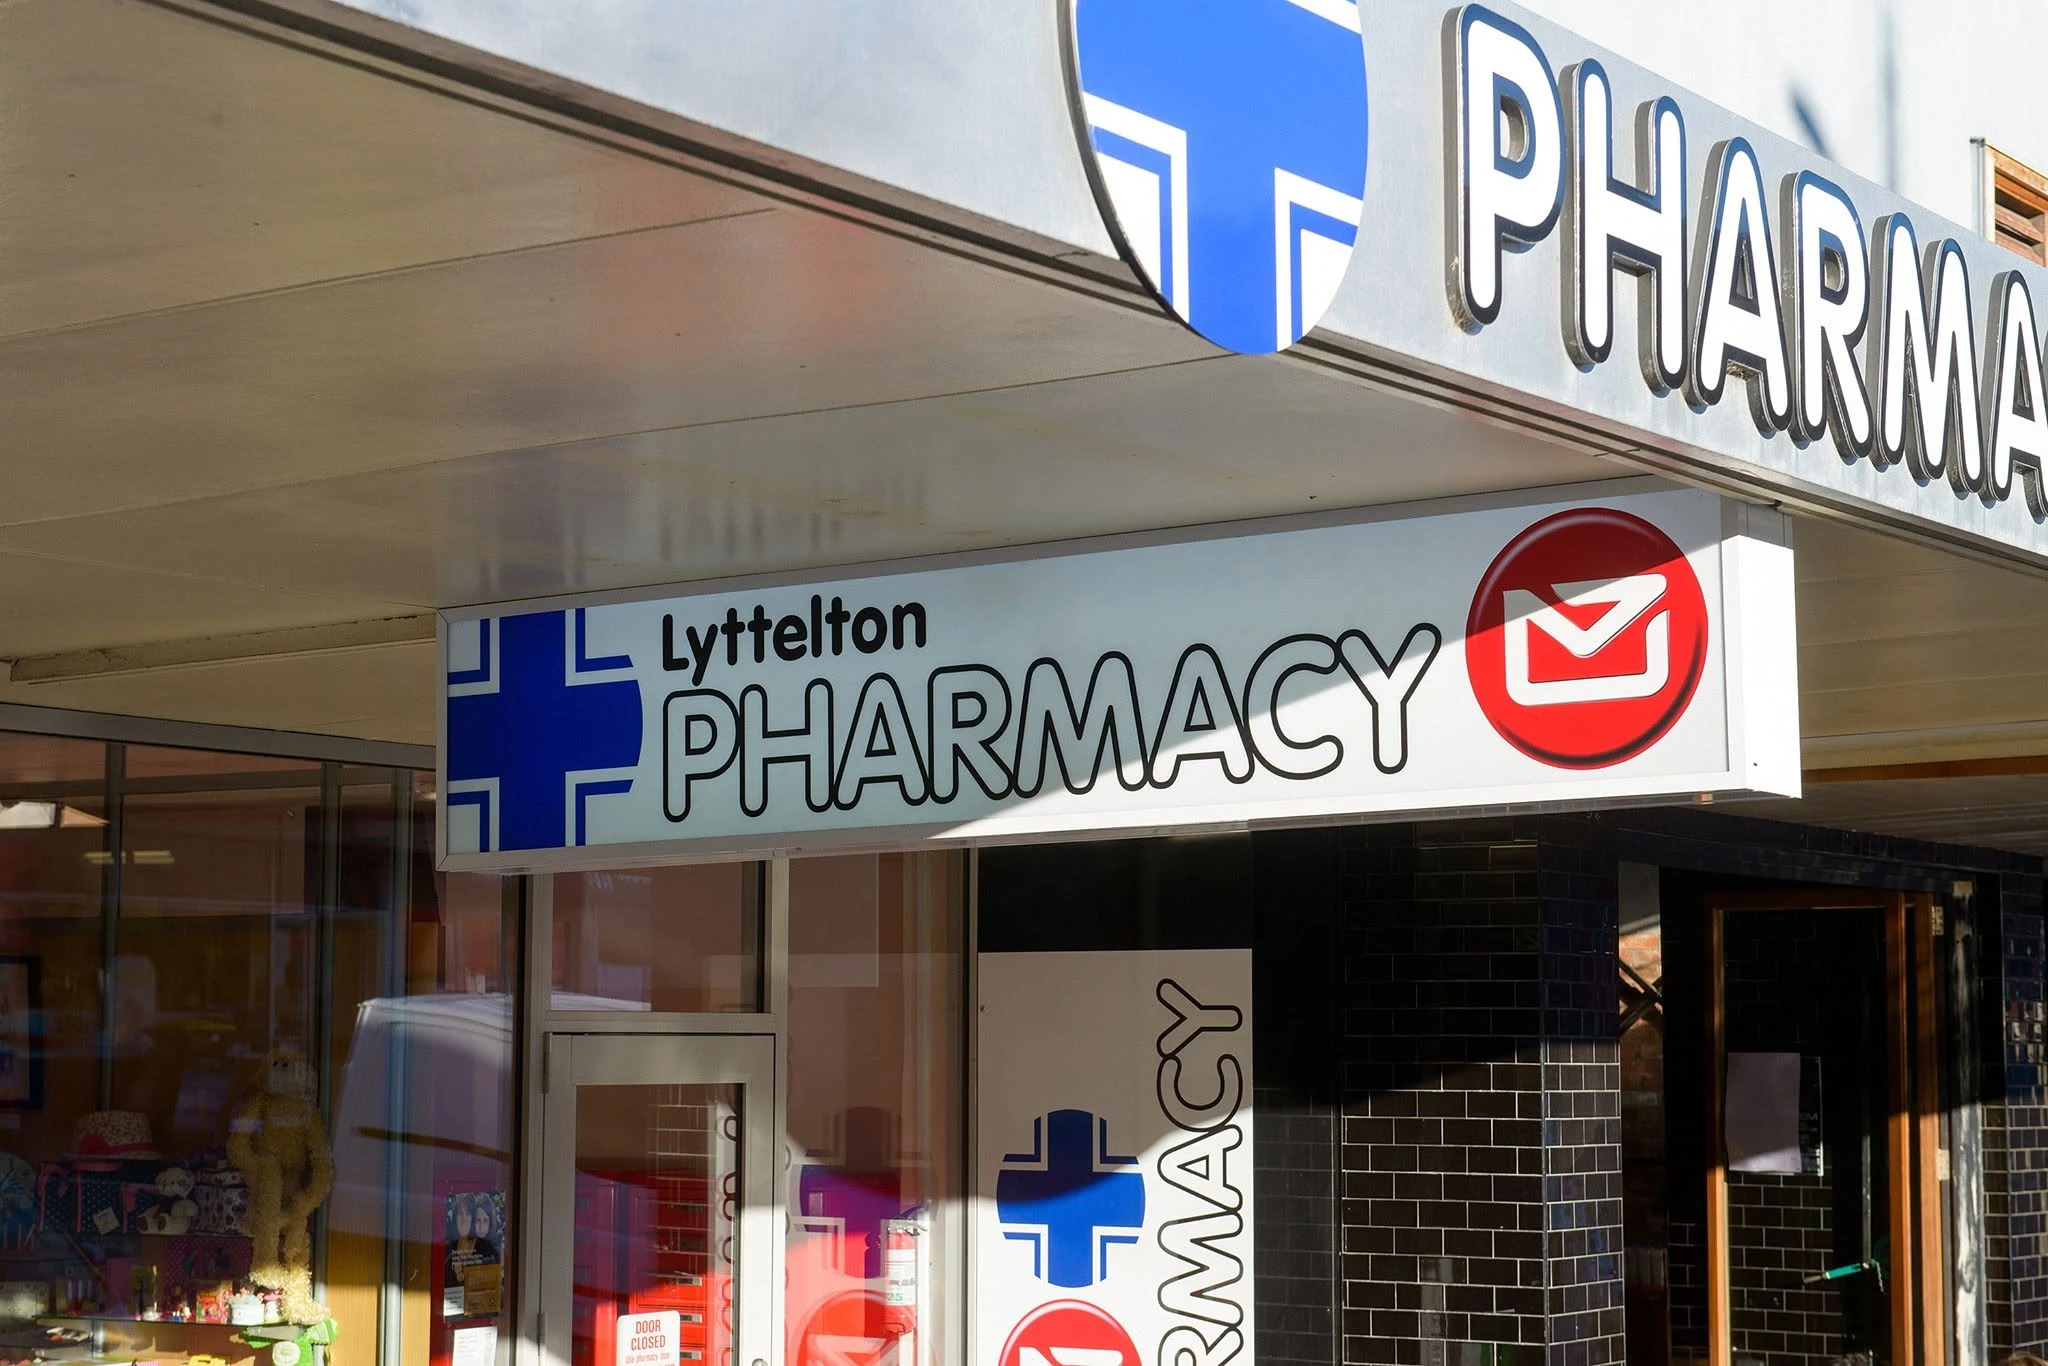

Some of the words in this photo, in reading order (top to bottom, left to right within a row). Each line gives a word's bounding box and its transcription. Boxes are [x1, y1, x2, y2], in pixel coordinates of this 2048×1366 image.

[1442, 3, 2048, 523] PHARMA
[662, 594, 927, 686] Lyttelton
[663, 622, 1443, 823] PHARMACY
[631, 1334, 666, 1351] CLOSED
[635, 1319, 661, 1334] DOOR
